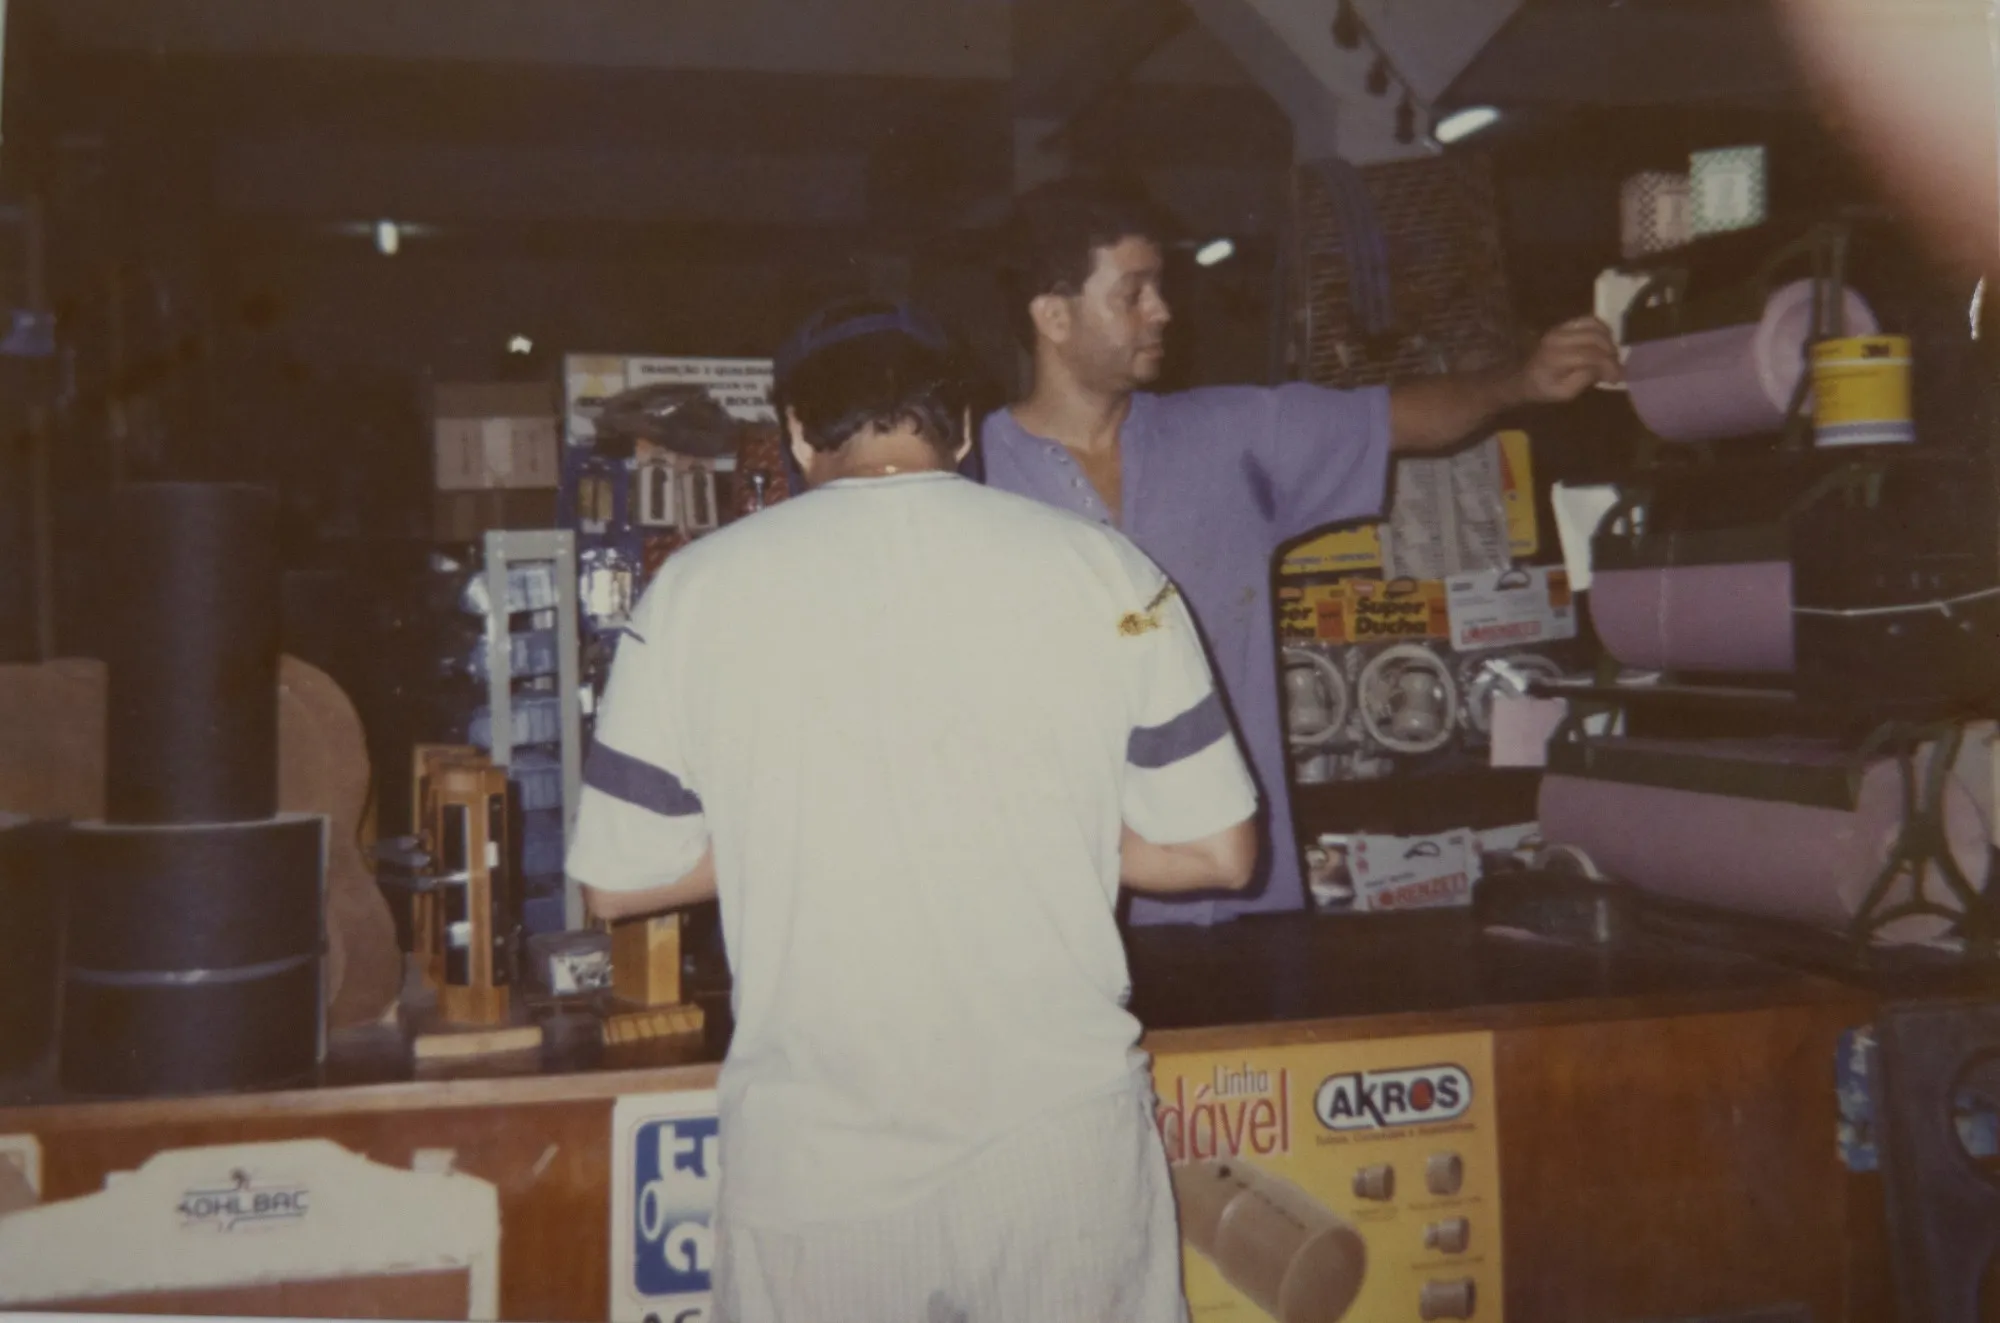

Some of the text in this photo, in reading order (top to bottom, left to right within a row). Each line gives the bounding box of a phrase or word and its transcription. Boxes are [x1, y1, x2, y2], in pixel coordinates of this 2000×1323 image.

[1355, 596, 1426, 618] Super
[1355, 615, 1427, 635] Ducha
[1213, 1062, 1268, 1096] Linha
[1156, 1067, 1289, 1164] dável
[1328, 1070, 1461, 1128] AKROS
